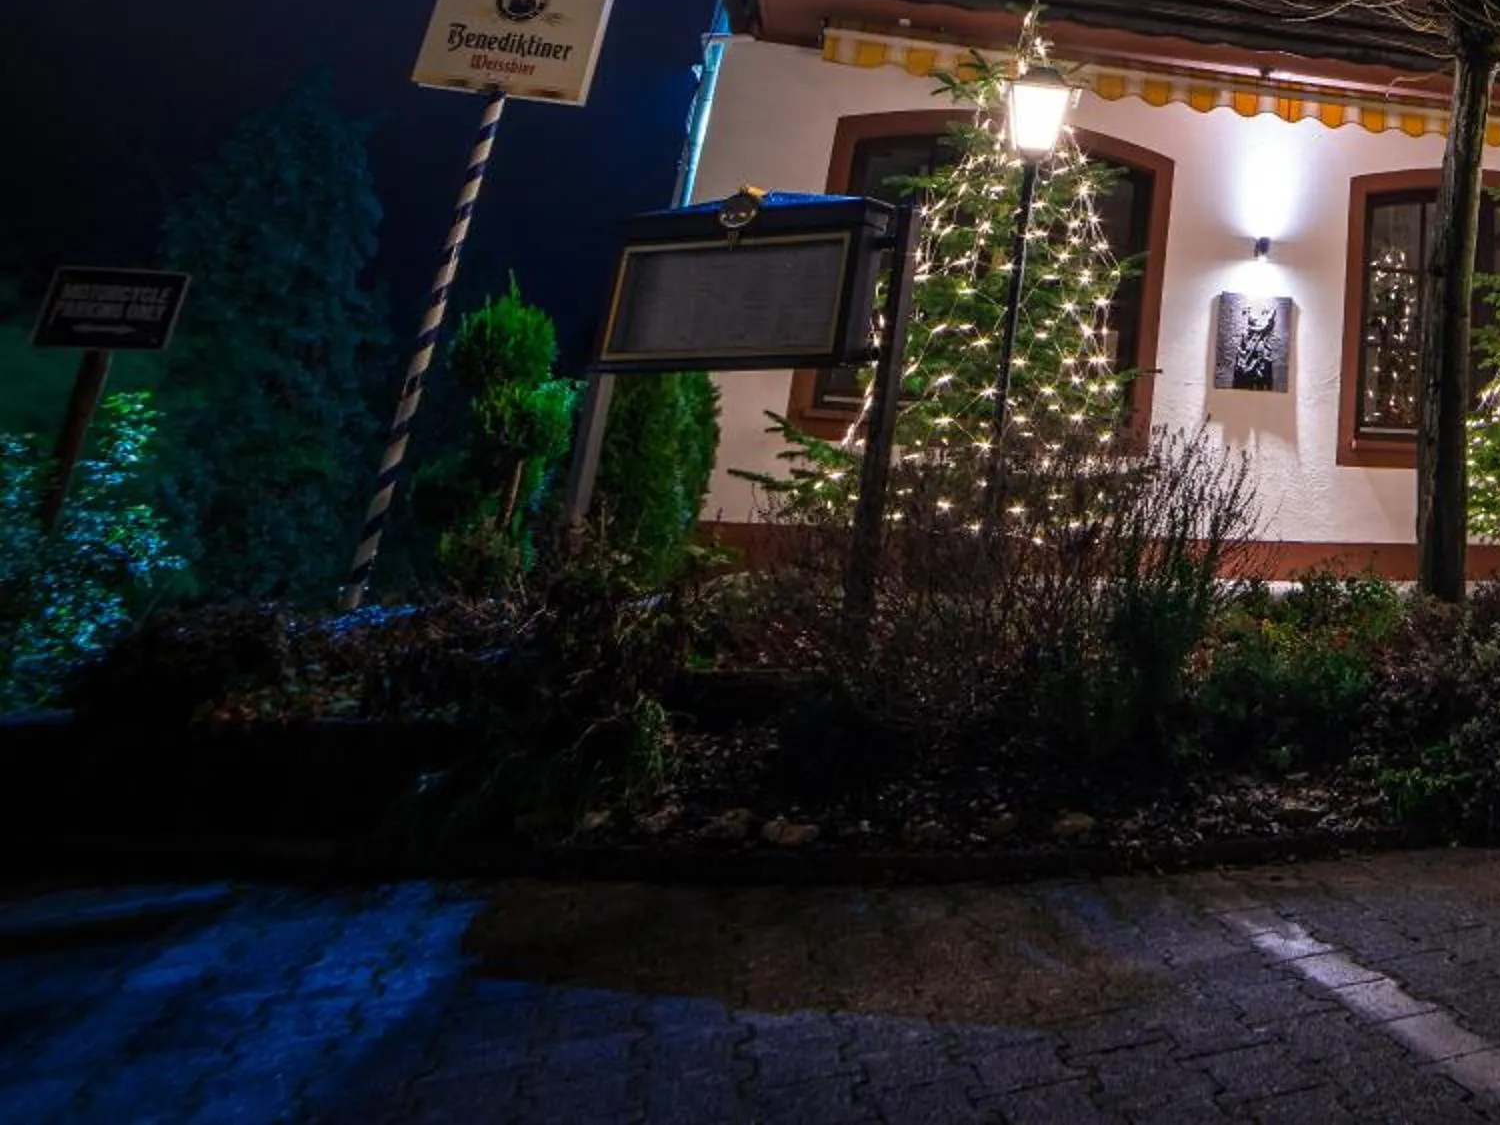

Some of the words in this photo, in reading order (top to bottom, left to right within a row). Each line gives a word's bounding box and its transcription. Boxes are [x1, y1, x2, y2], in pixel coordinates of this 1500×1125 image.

[447, 23, 573, 61] Benediktiner
[471, 55, 537, 76] Weissbier
[126, 303, 169, 321] ONLY
